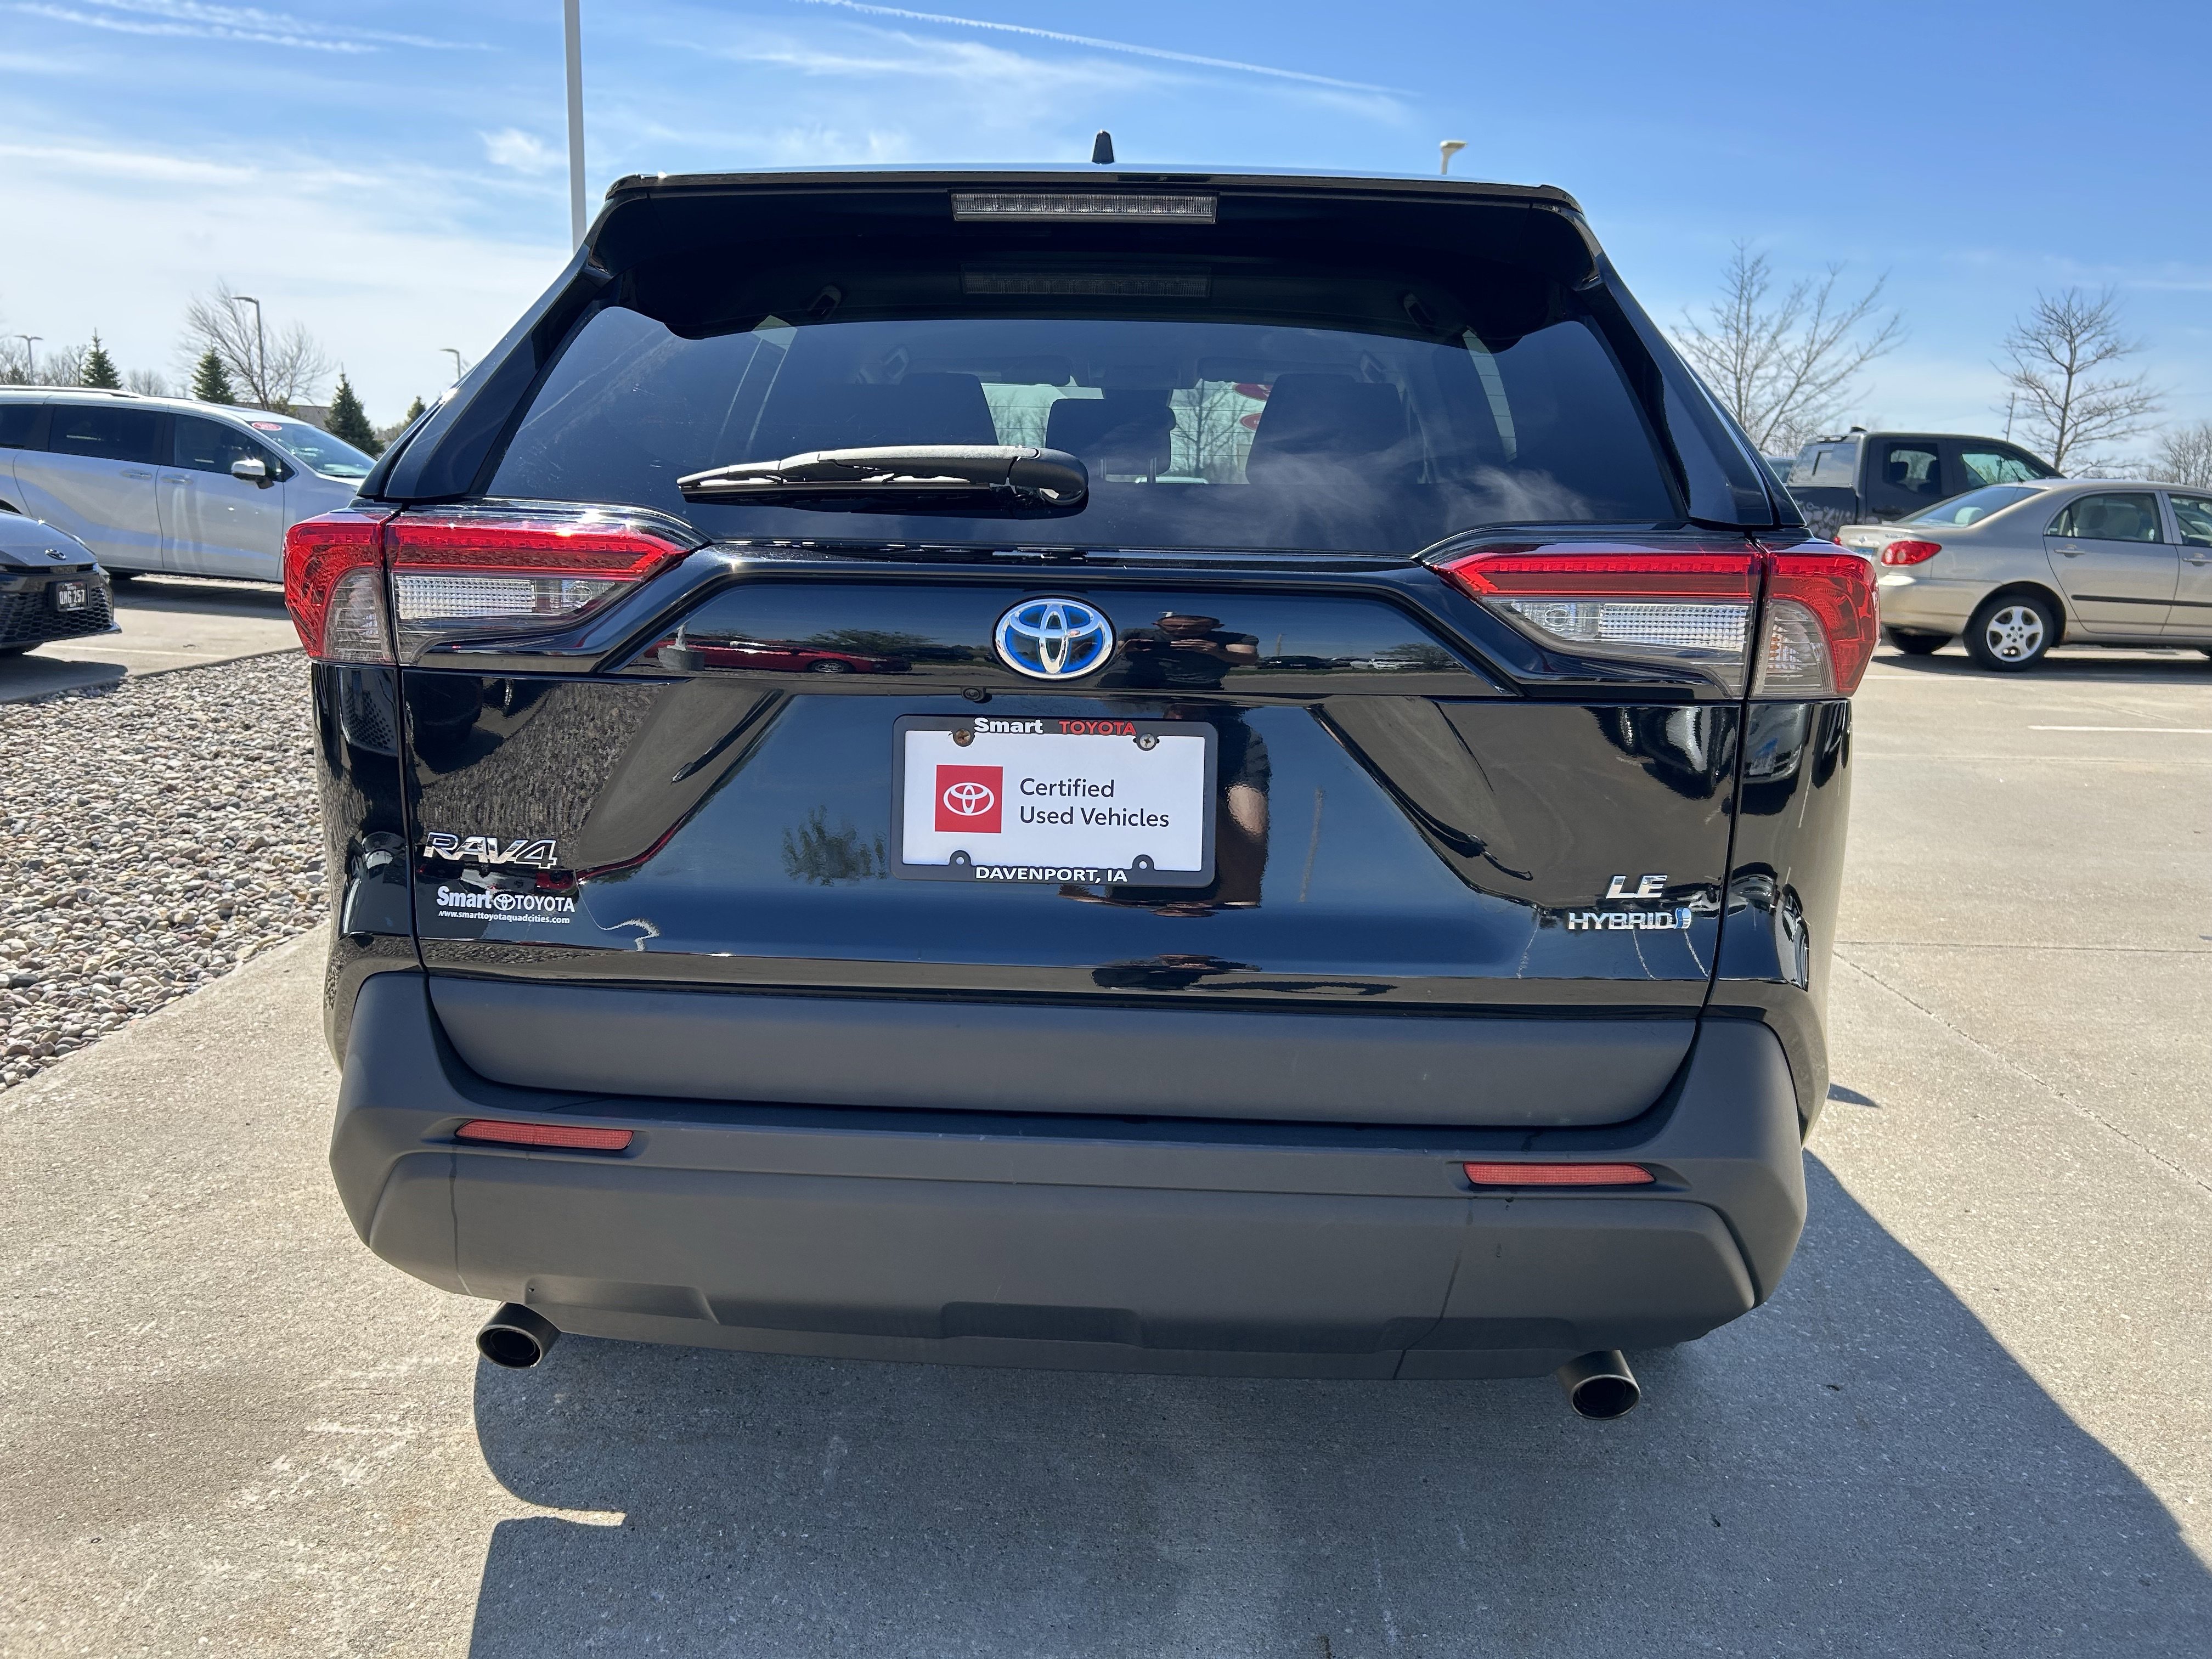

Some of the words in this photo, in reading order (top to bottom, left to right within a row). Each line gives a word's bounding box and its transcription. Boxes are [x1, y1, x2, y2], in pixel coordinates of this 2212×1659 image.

[974, 718, 1043, 733] Smart
[1059, 721, 1137, 736] TOYOTA
[1020, 778, 1115, 798] Certified
[1020, 806, 1074, 825] Used
[1081, 808, 1170, 827] Vehicles
[423, 832, 557, 869] RAV4
[976, 867, 1101, 883] DAVENPORT,
[1107, 870, 1128, 882] IA
[1605, 875, 1668, 899] LE
[437, 885, 492, 909] Smart
[515, 895, 575, 912] TOYOTA
[438, 911, 570, 924] www.smarttoyotaquadcities.com
[1568, 912, 1675, 930] HYBRID
